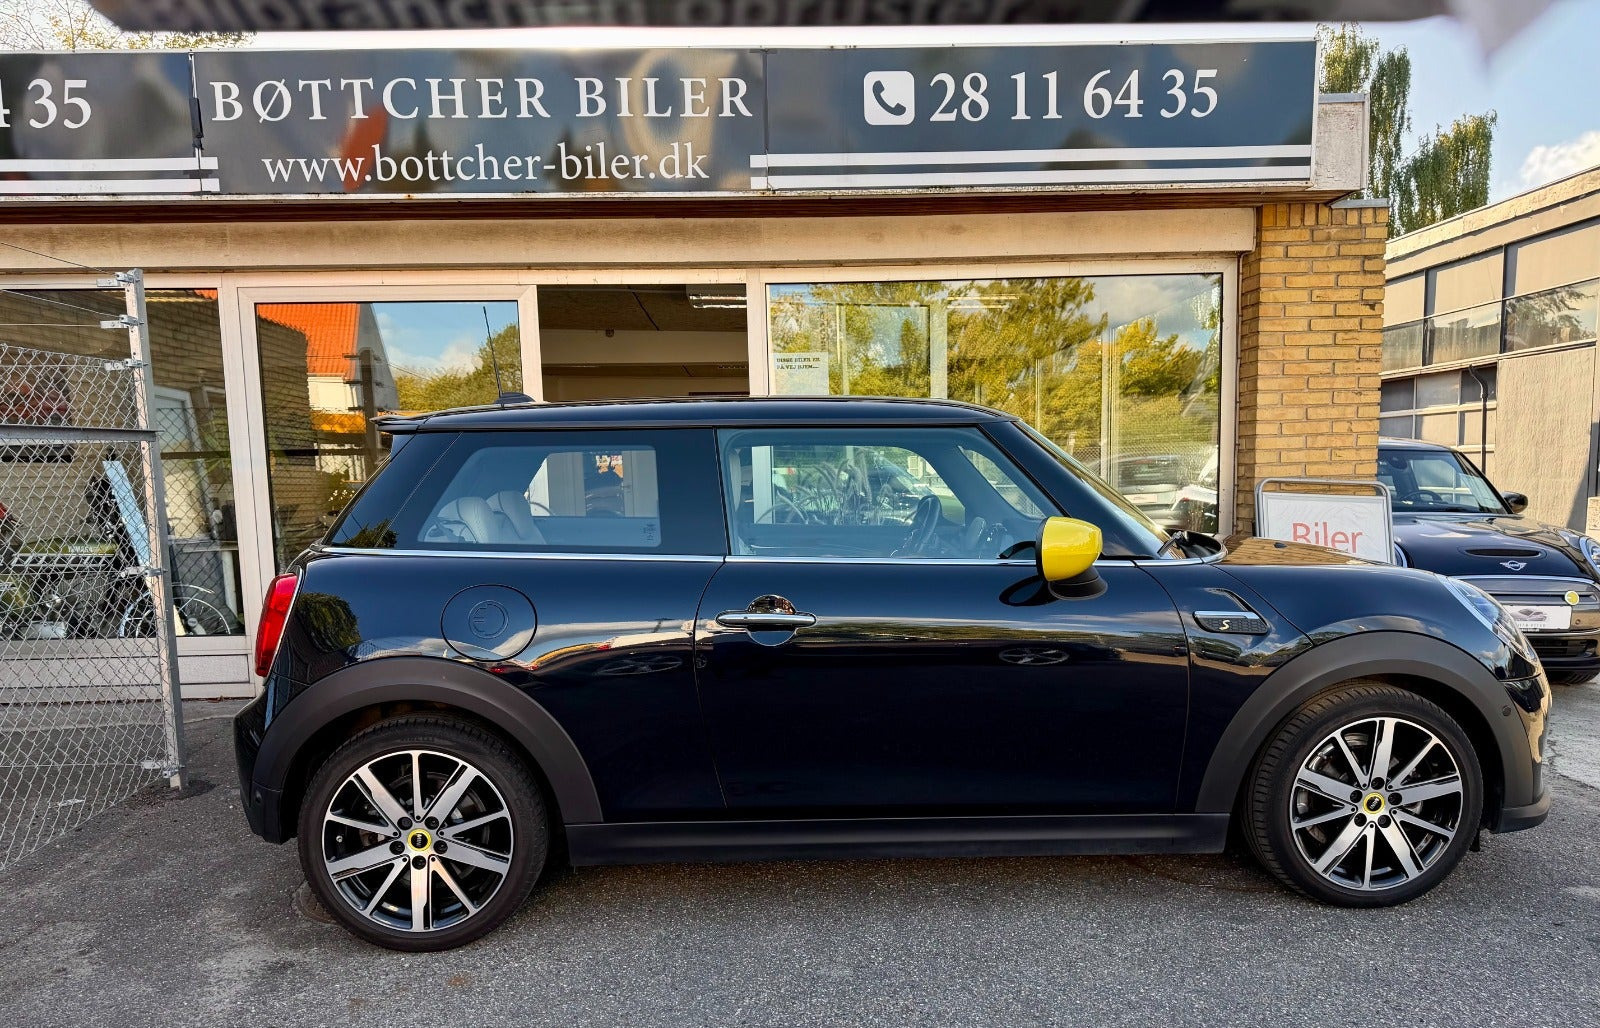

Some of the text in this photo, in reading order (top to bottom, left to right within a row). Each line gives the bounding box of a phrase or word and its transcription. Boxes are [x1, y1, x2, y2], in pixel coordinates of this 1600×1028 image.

[27, 78, 92, 129] 35
[209, 77, 753, 123] BØTTCHER BILER
[929, 68, 1219, 122] 28 11 64 35
[261, 142, 710, 184] www.bottcher-biler.dk
[1219, 619, 1231, 631] S
